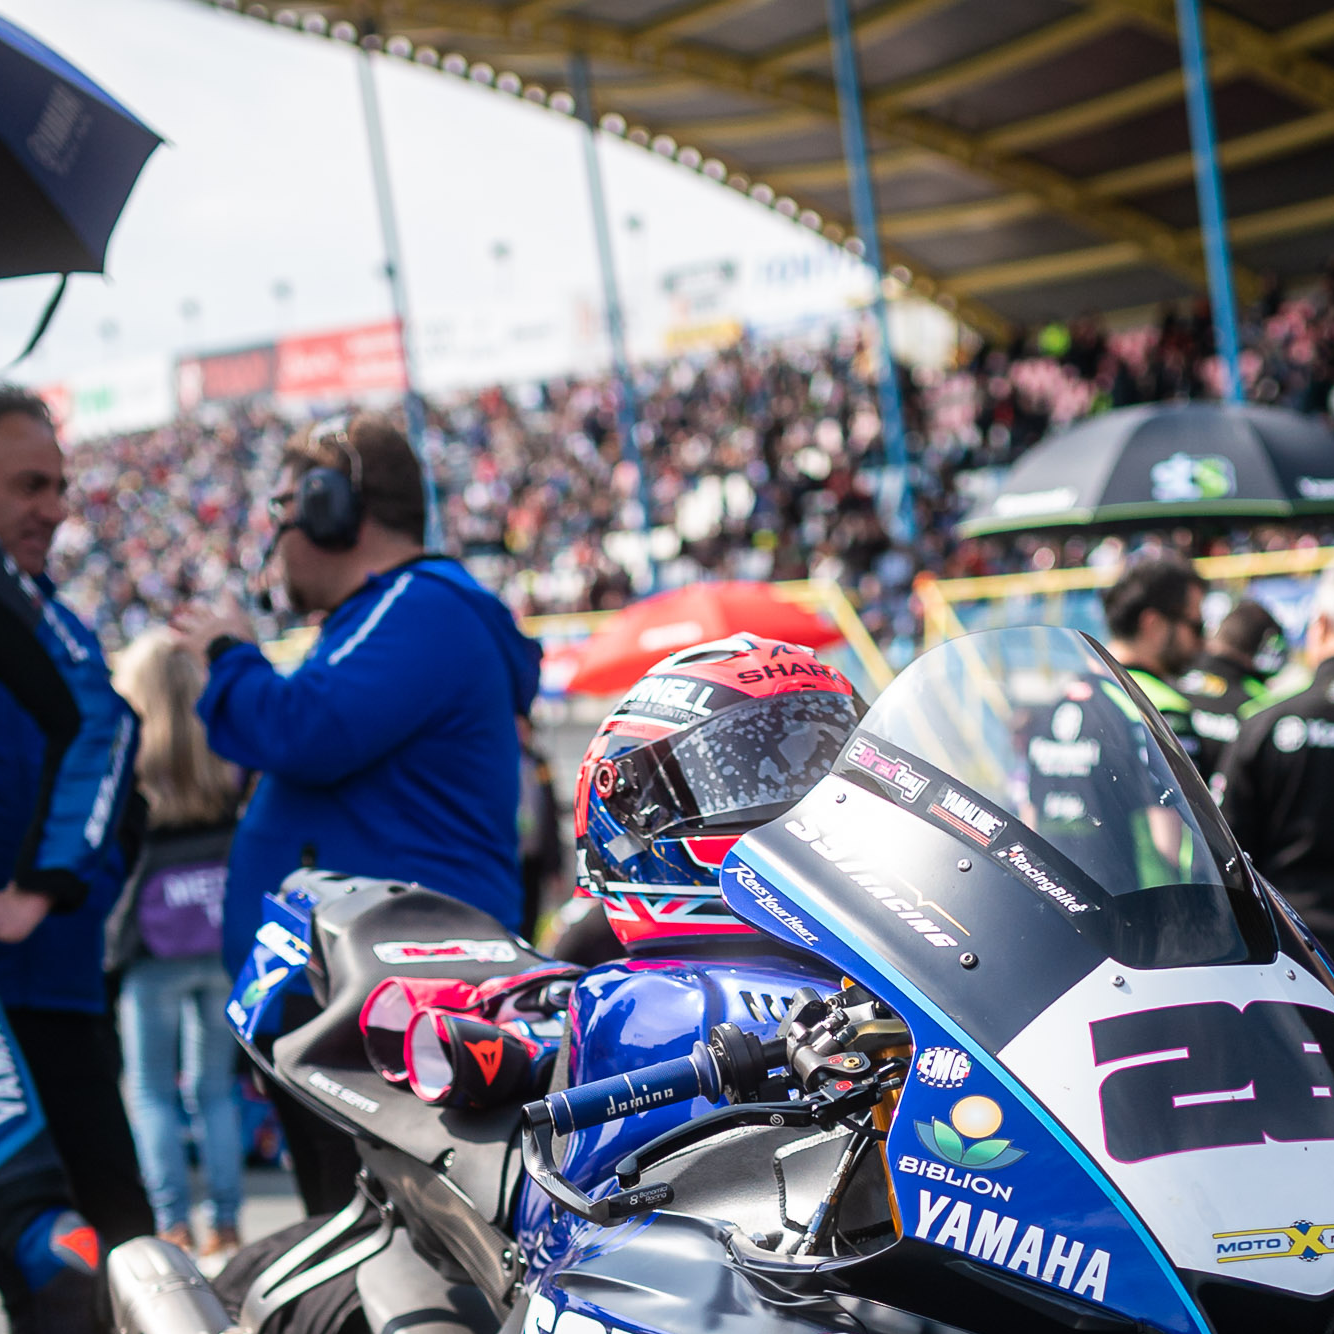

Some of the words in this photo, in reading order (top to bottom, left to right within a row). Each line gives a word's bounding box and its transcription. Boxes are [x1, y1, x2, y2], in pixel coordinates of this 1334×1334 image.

[919, 1050, 970, 1081] EMG
[606, 1083, 674, 1117] domino
[898, 1154, 1013, 1202] BIBLION
[645, 1192, 667, 1203] Racing
[915, 1189, 1111, 1303] YAMAHA
[1217, 1238, 1281, 1255] MOTO
